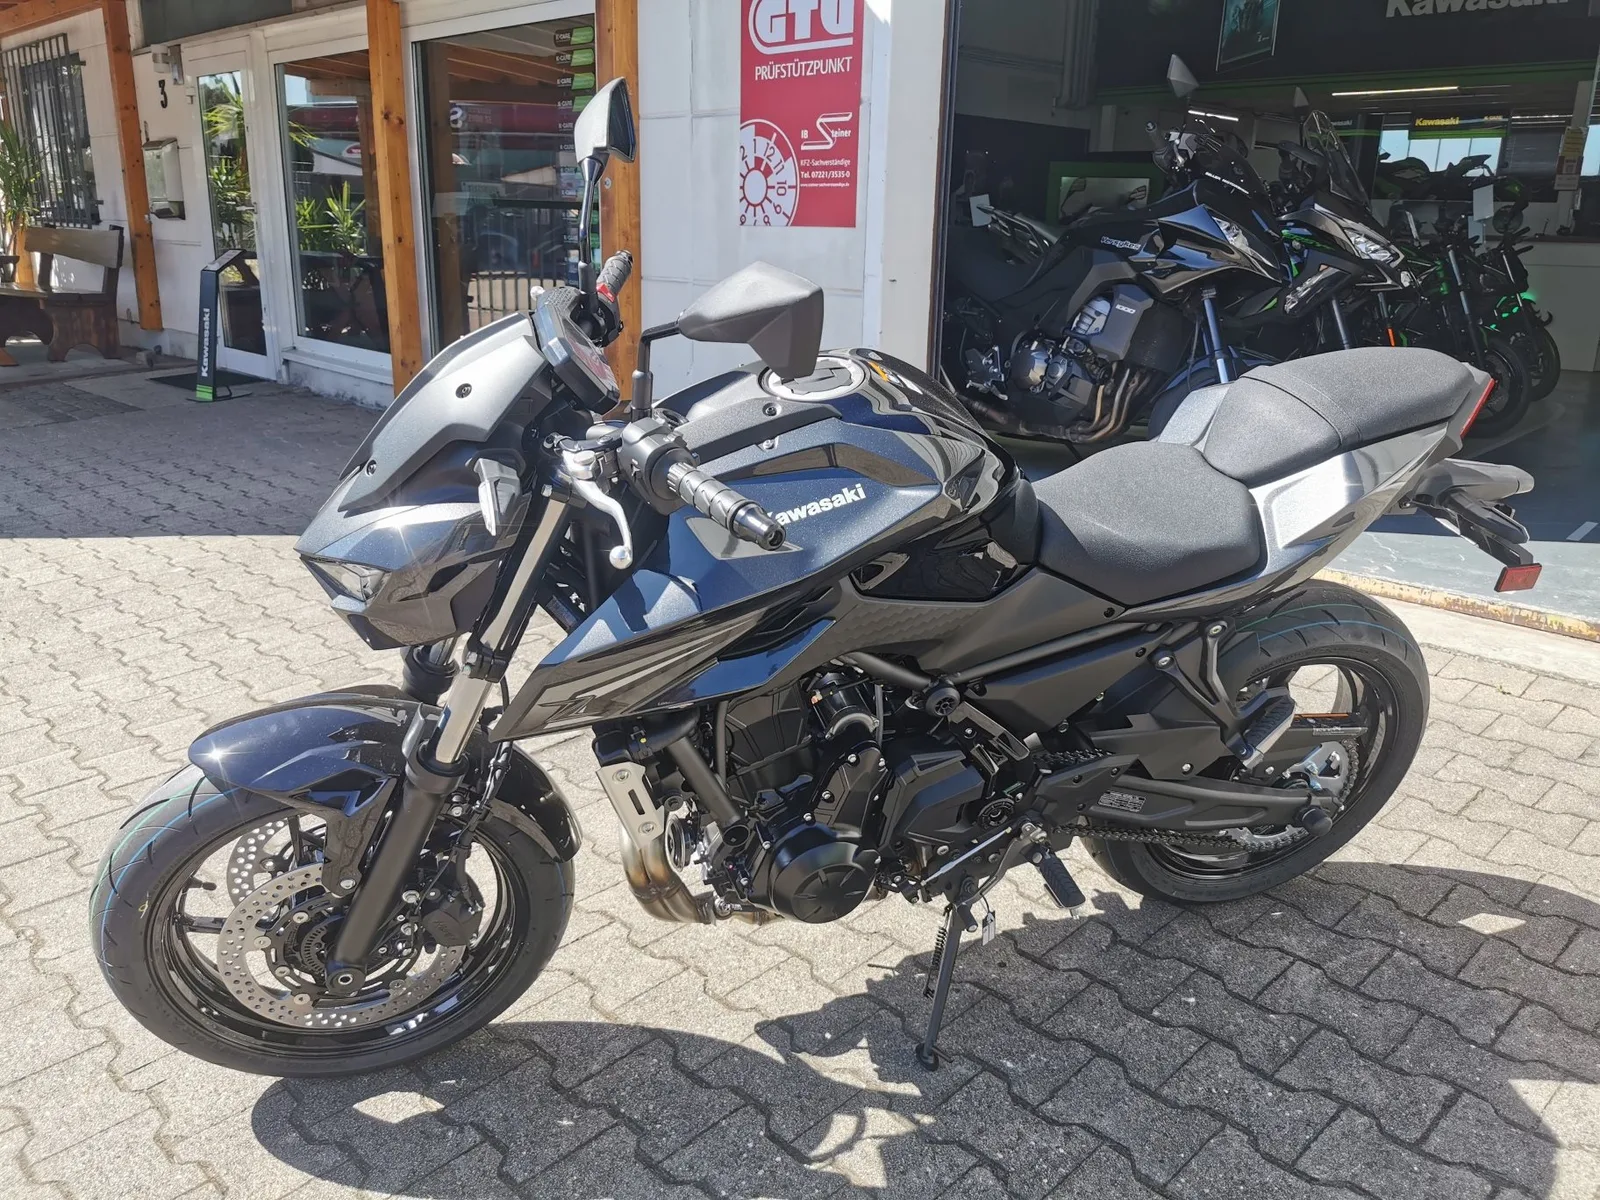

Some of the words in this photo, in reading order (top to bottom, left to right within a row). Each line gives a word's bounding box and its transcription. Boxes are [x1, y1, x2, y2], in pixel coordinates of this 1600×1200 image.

[755, 56, 852, 81] PRÜFSTÜTZPUNKT
[158, 79, 168, 109] 3
[801, 129, 809, 139] IB
[1415, 117, 1459, 127] Kawasaki
[811, 170, 851, 179] 07221/3535-0
[201, 308, 210, 377] Kawasaki
[767, 483, 867, 526] awasaki
